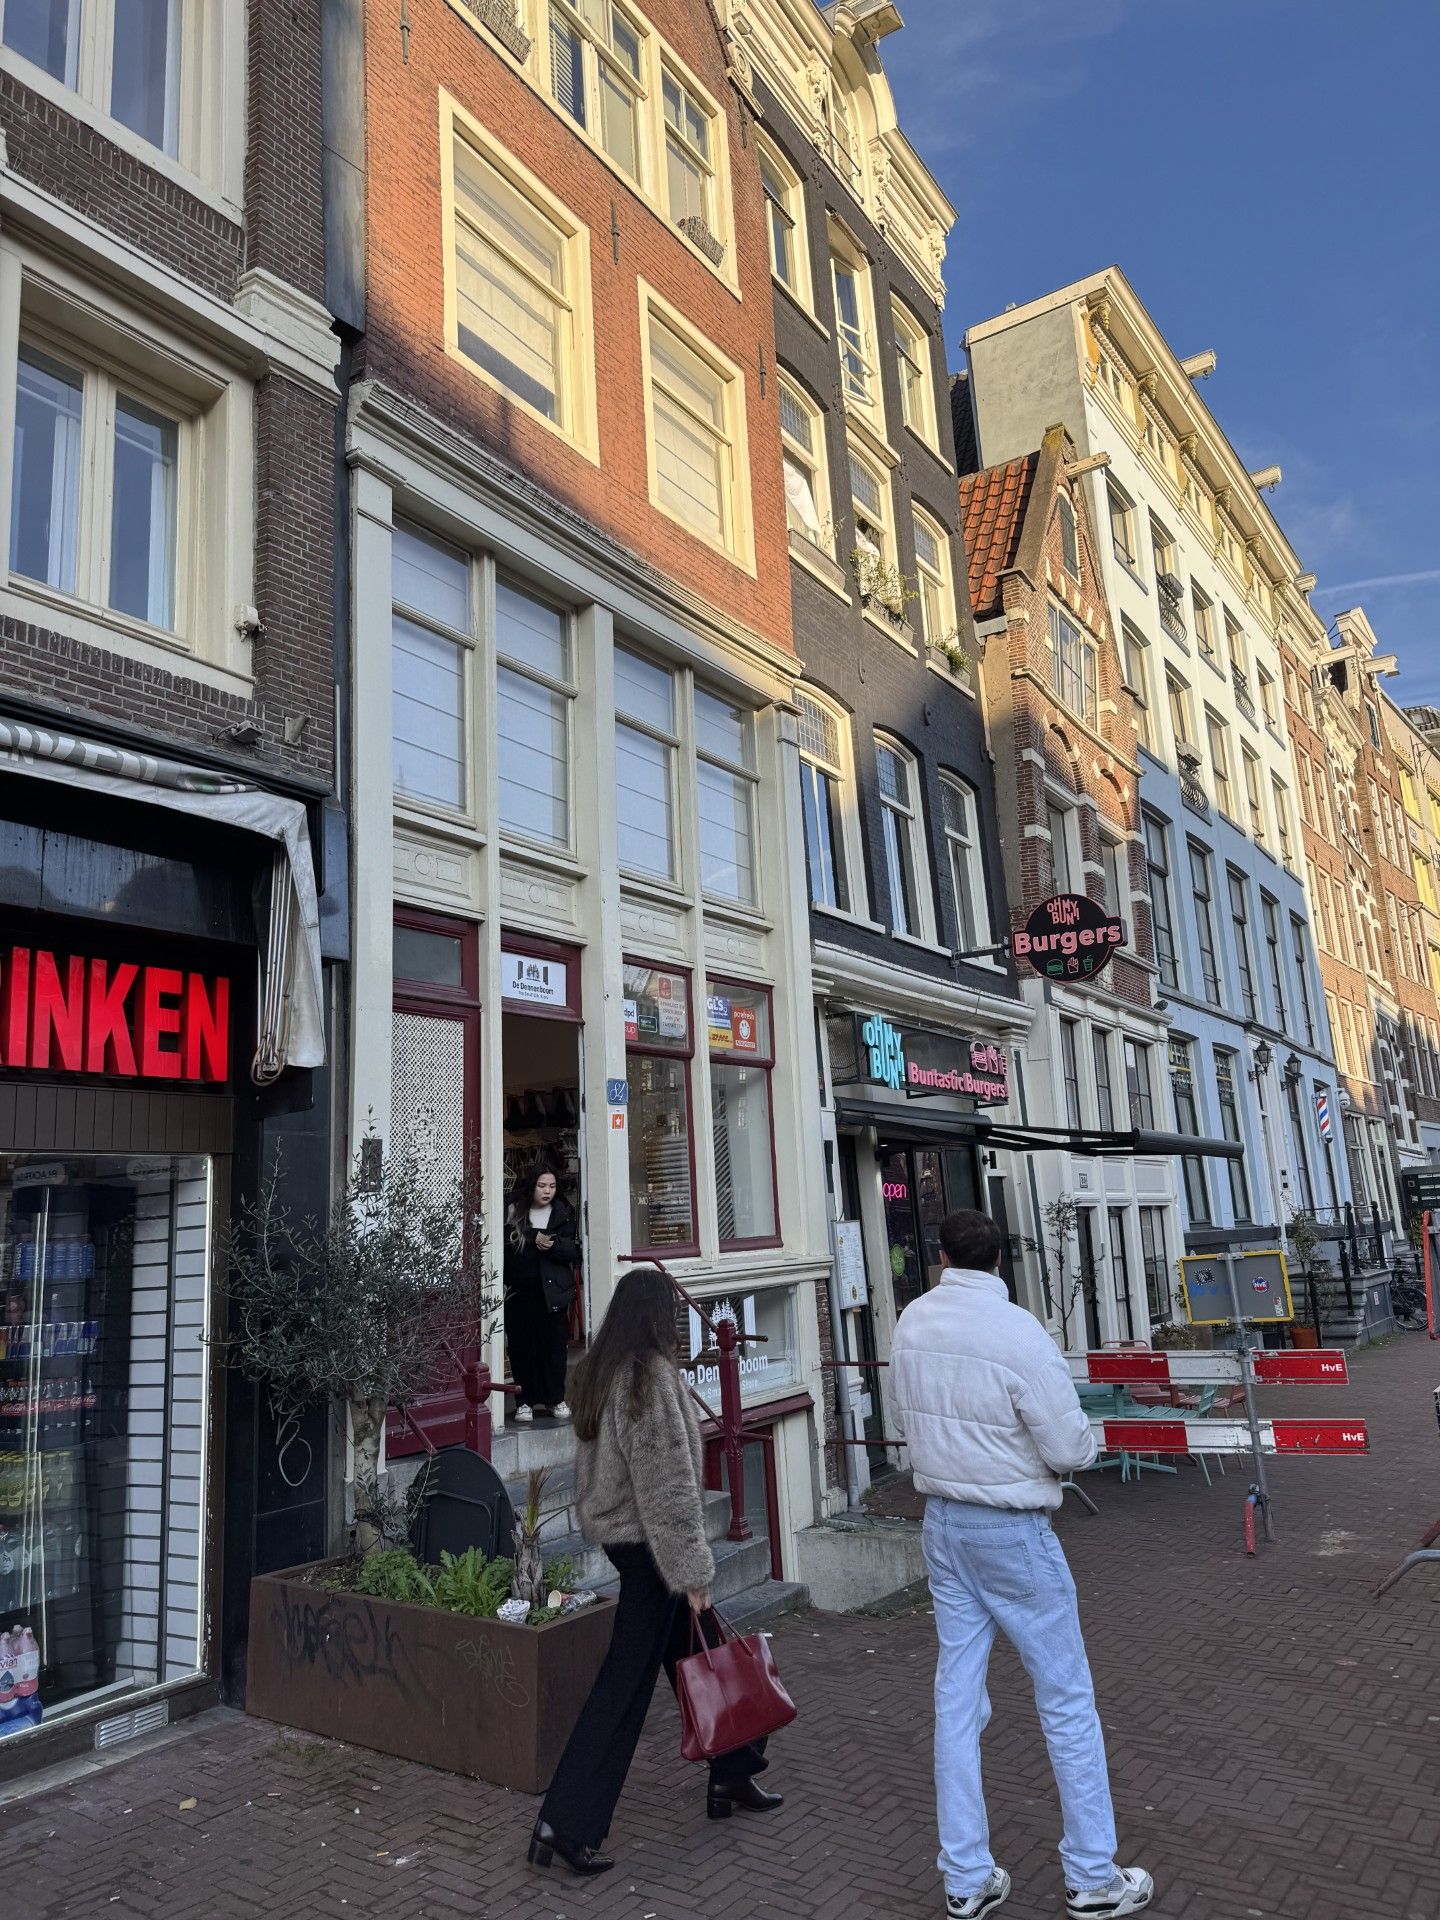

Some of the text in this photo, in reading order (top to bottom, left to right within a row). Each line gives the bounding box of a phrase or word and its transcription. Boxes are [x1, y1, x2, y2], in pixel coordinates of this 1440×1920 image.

[1014, 925, 1121, 955] Burgers
[512, 981, 520, 989] De
[707, 998, 724, 1011] GLS
[0, 946, 230, 1083] INKEN
[624, 1008, 635, 1018] dpd
[862, 1013, 883, 1047] OH
[907, 1061, 965, 1092] Buntastic
[882, 1183, 907, 1202] open
[697, 1354, 769, 1384] Denboom
[1321, 1363, 1343, 1372] HvE
[1342, 1432, 1365, 1441] HvE
[0, 1657, 18, 1669] vian
